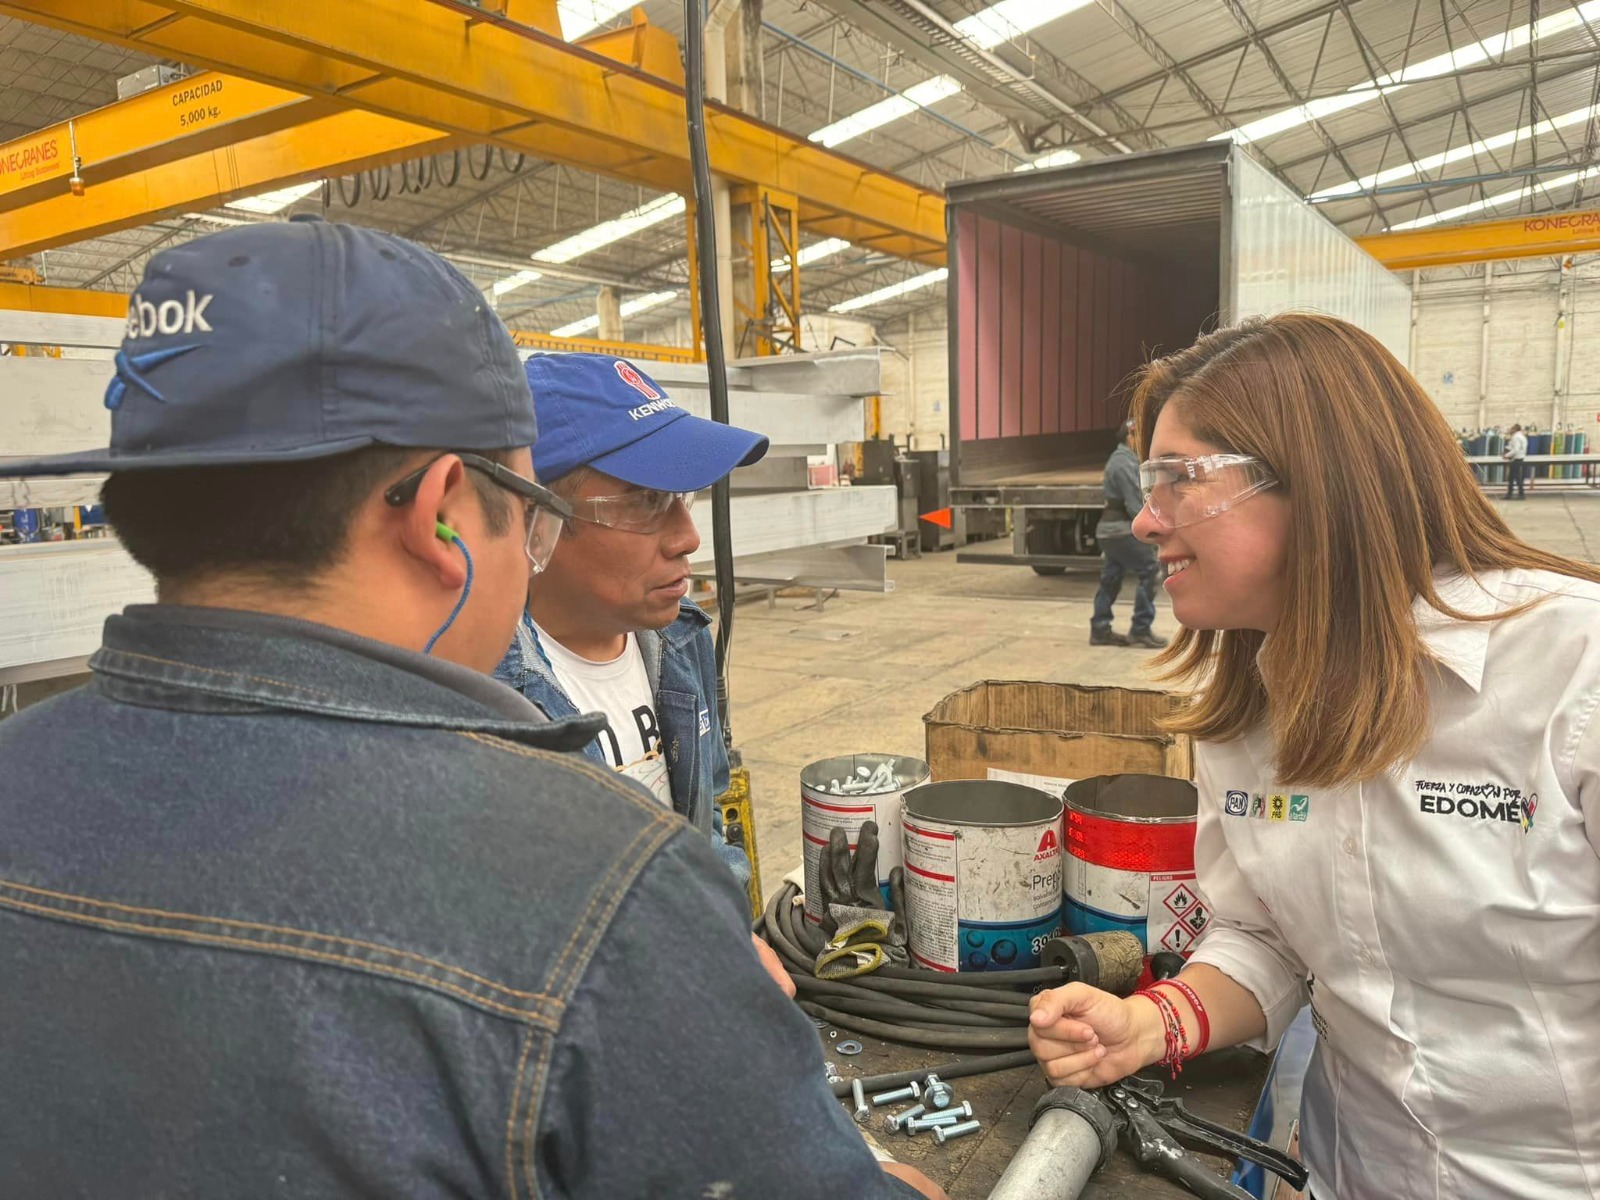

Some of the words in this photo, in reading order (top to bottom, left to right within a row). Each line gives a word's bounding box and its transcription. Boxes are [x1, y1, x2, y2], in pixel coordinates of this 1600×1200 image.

[172, 79, 223, 107] CAPACIDAD
[180, 108, 206, 127] 5,000
[0, 139, 58, 176] NECRANES
[1415, 780, 1447, 793] FUERZA
[1449, 782, 1456, 793] Y
[1503, 787, 1521, 800] POR
